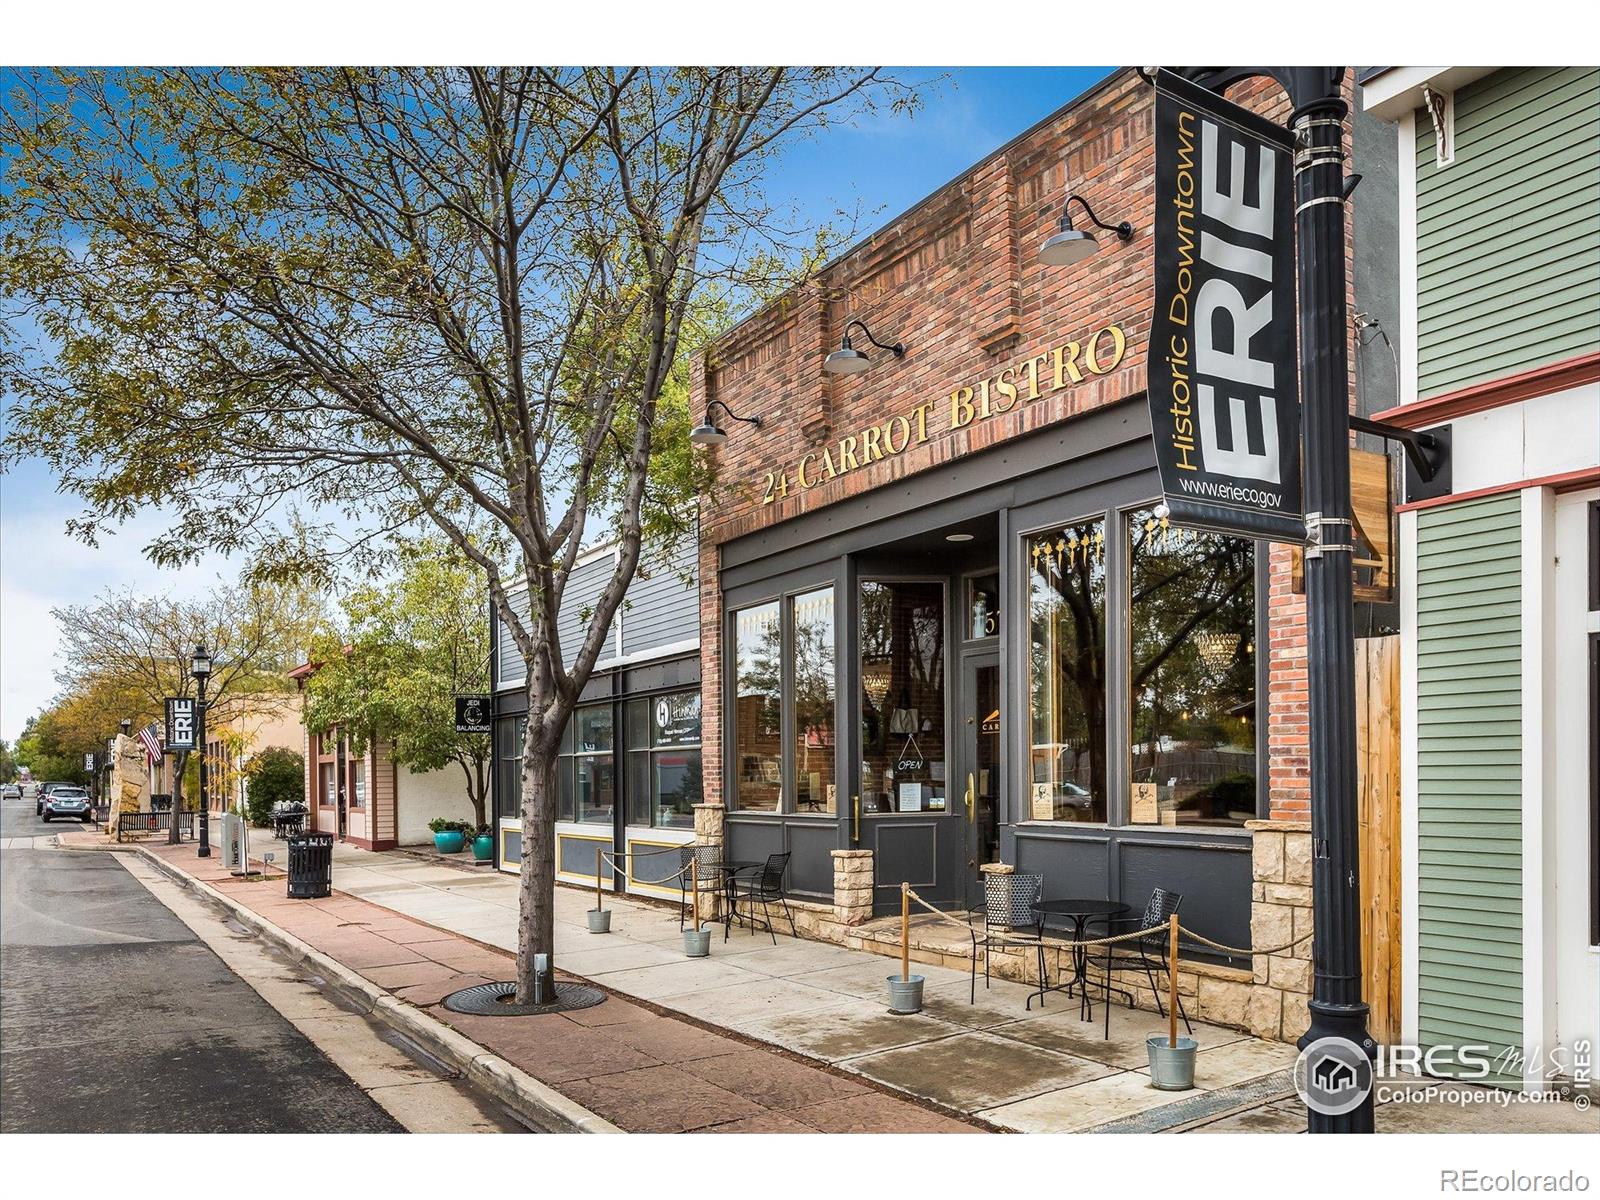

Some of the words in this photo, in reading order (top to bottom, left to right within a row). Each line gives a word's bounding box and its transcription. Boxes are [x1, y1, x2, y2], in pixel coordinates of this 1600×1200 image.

[1169, 111, 1195, 327] Downtown
[1194, 119, 1281, 485] ERIE
[762, 465, 789, 505] 24
[798, 400, 935, 490] CARROT
[949, 326, 1127, 431] BISTRO
[1166, 335, 1197, 471] Historic
[1179, 478, 1282, 508] www.erieco.gov
[985, 610, 1000, 634] 5
[174, 700, 193, 743] ERIE
[898, 760, 923, 771] OPEN
